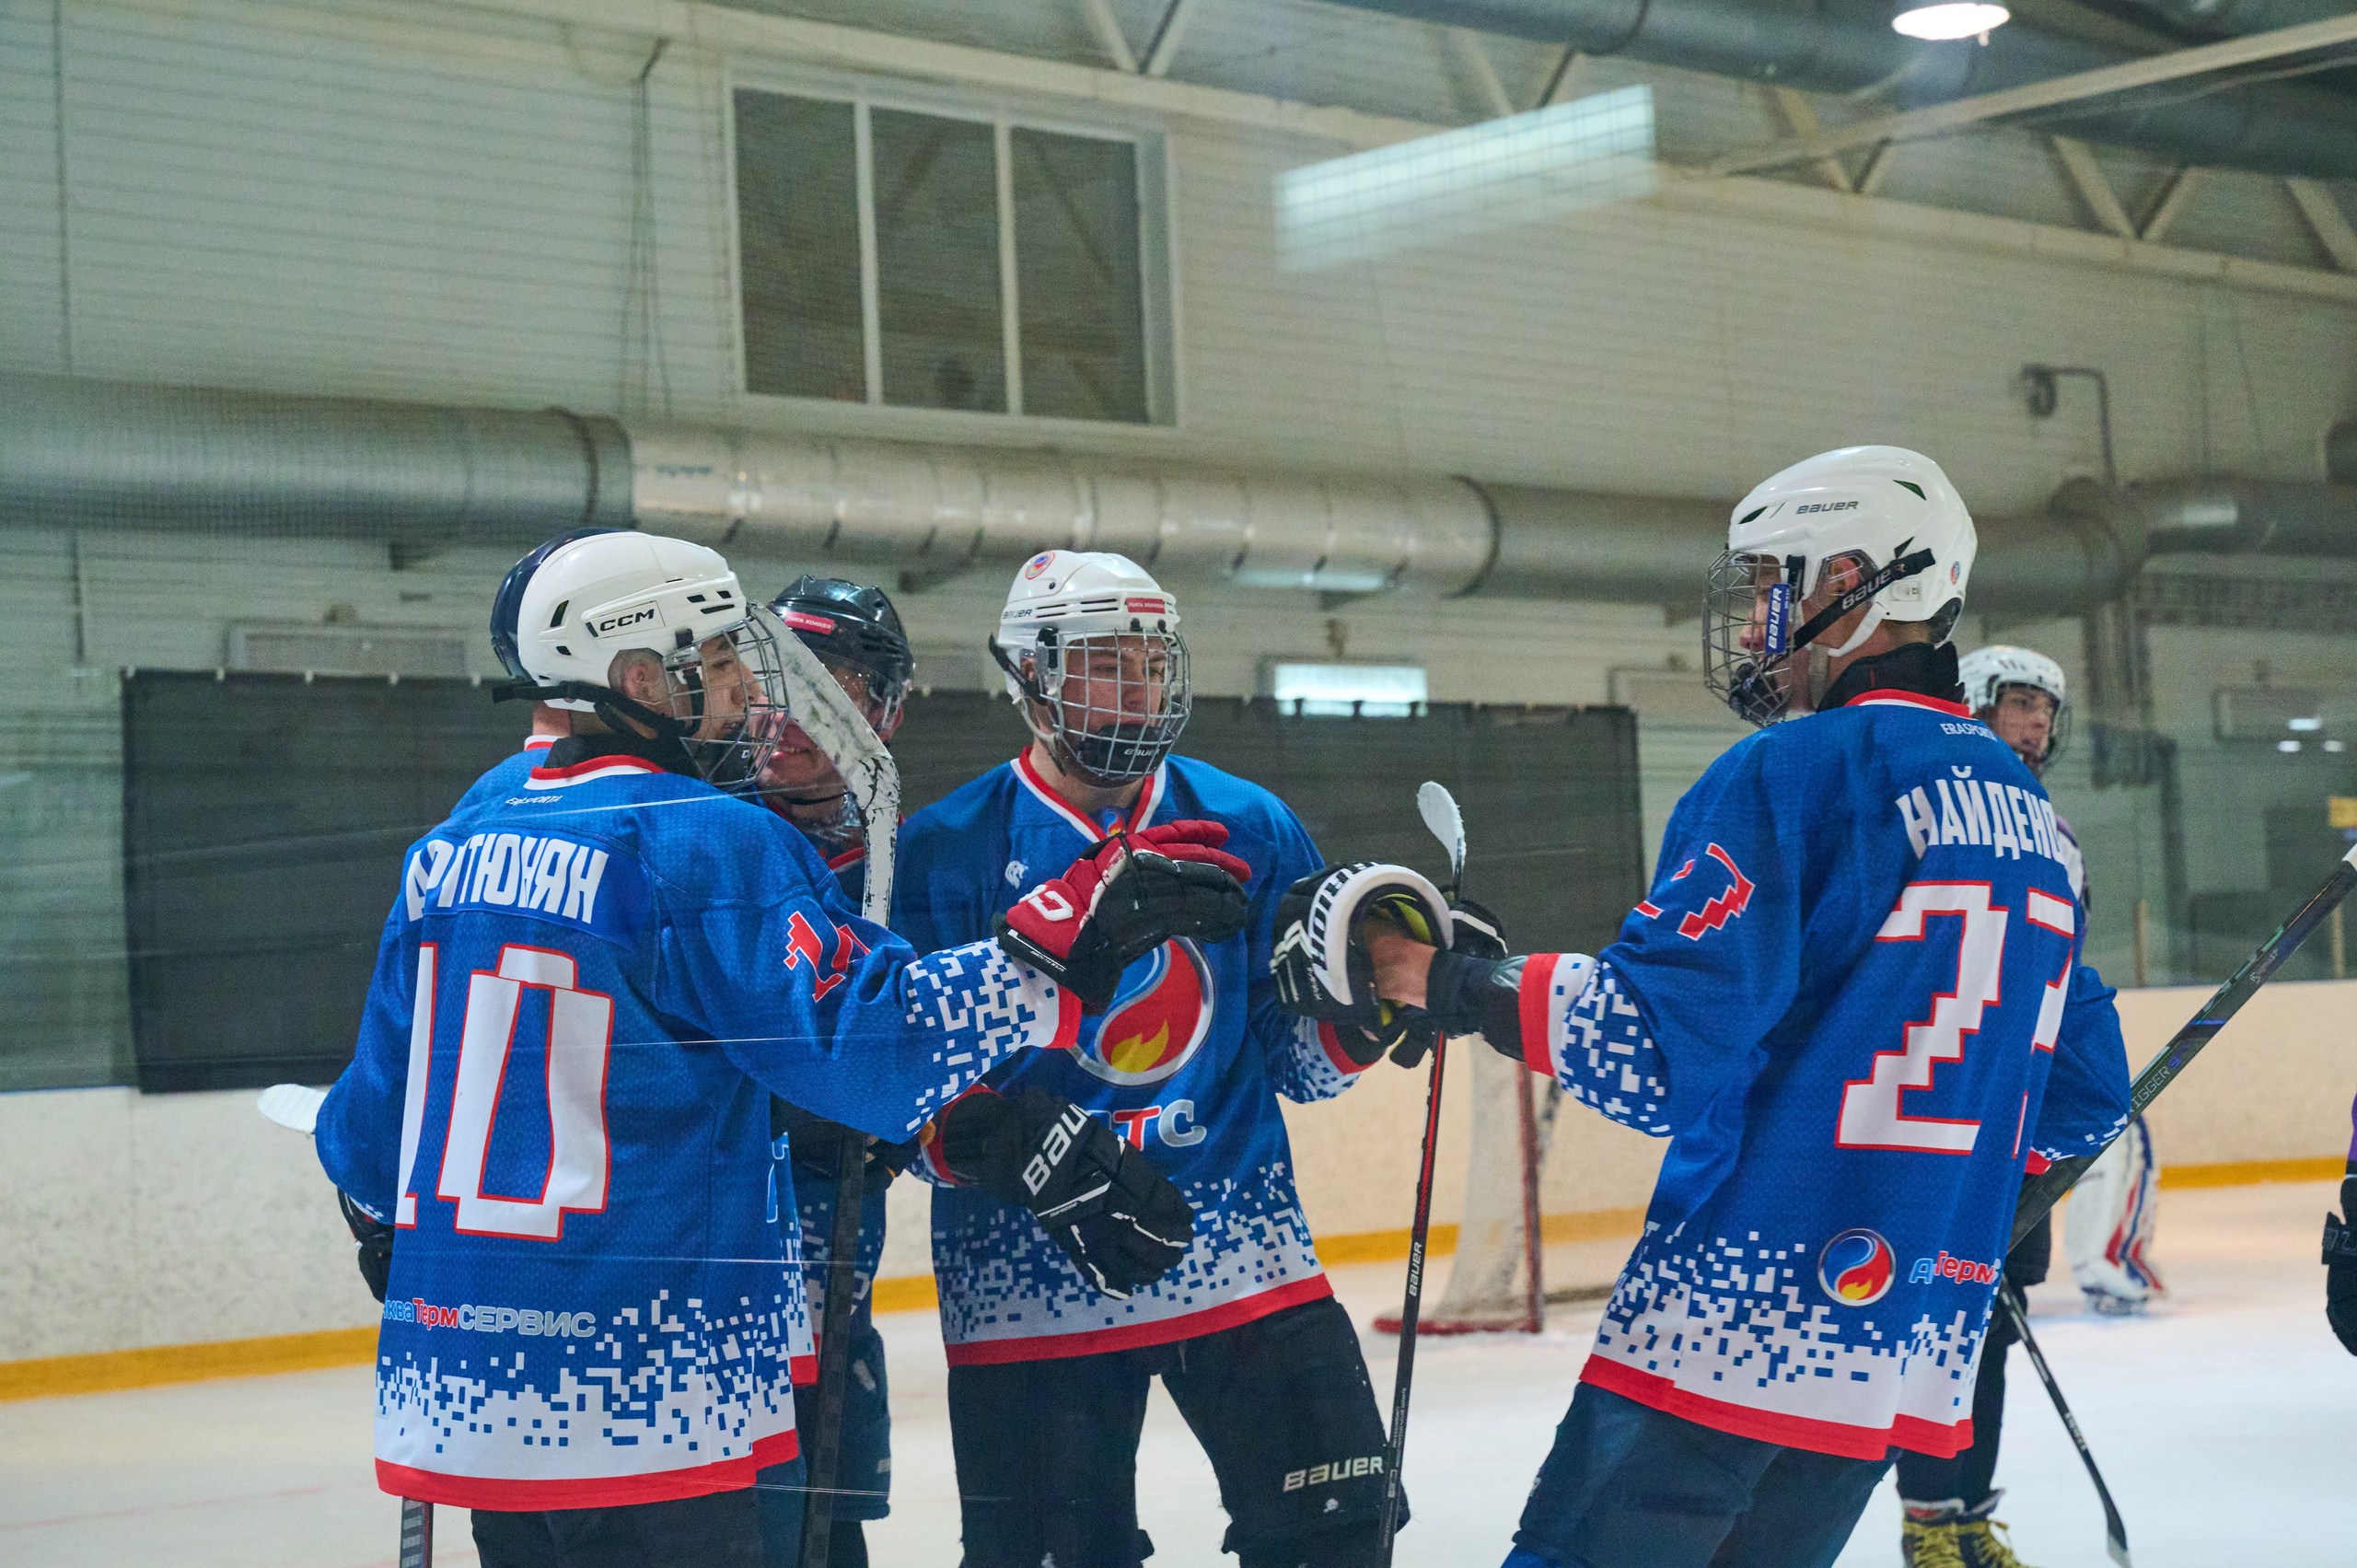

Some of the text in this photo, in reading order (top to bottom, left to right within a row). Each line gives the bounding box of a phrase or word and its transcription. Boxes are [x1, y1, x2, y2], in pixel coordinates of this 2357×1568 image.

[1796, 500, 1860, 516] BAUER
[599, 608, 655, 633] CCM
[1767, 587, 1783, 650] BAUER
[1408, 1241, 1423, 1298] BAUER
[1282, 1455, 1385, 1493] BAUER
